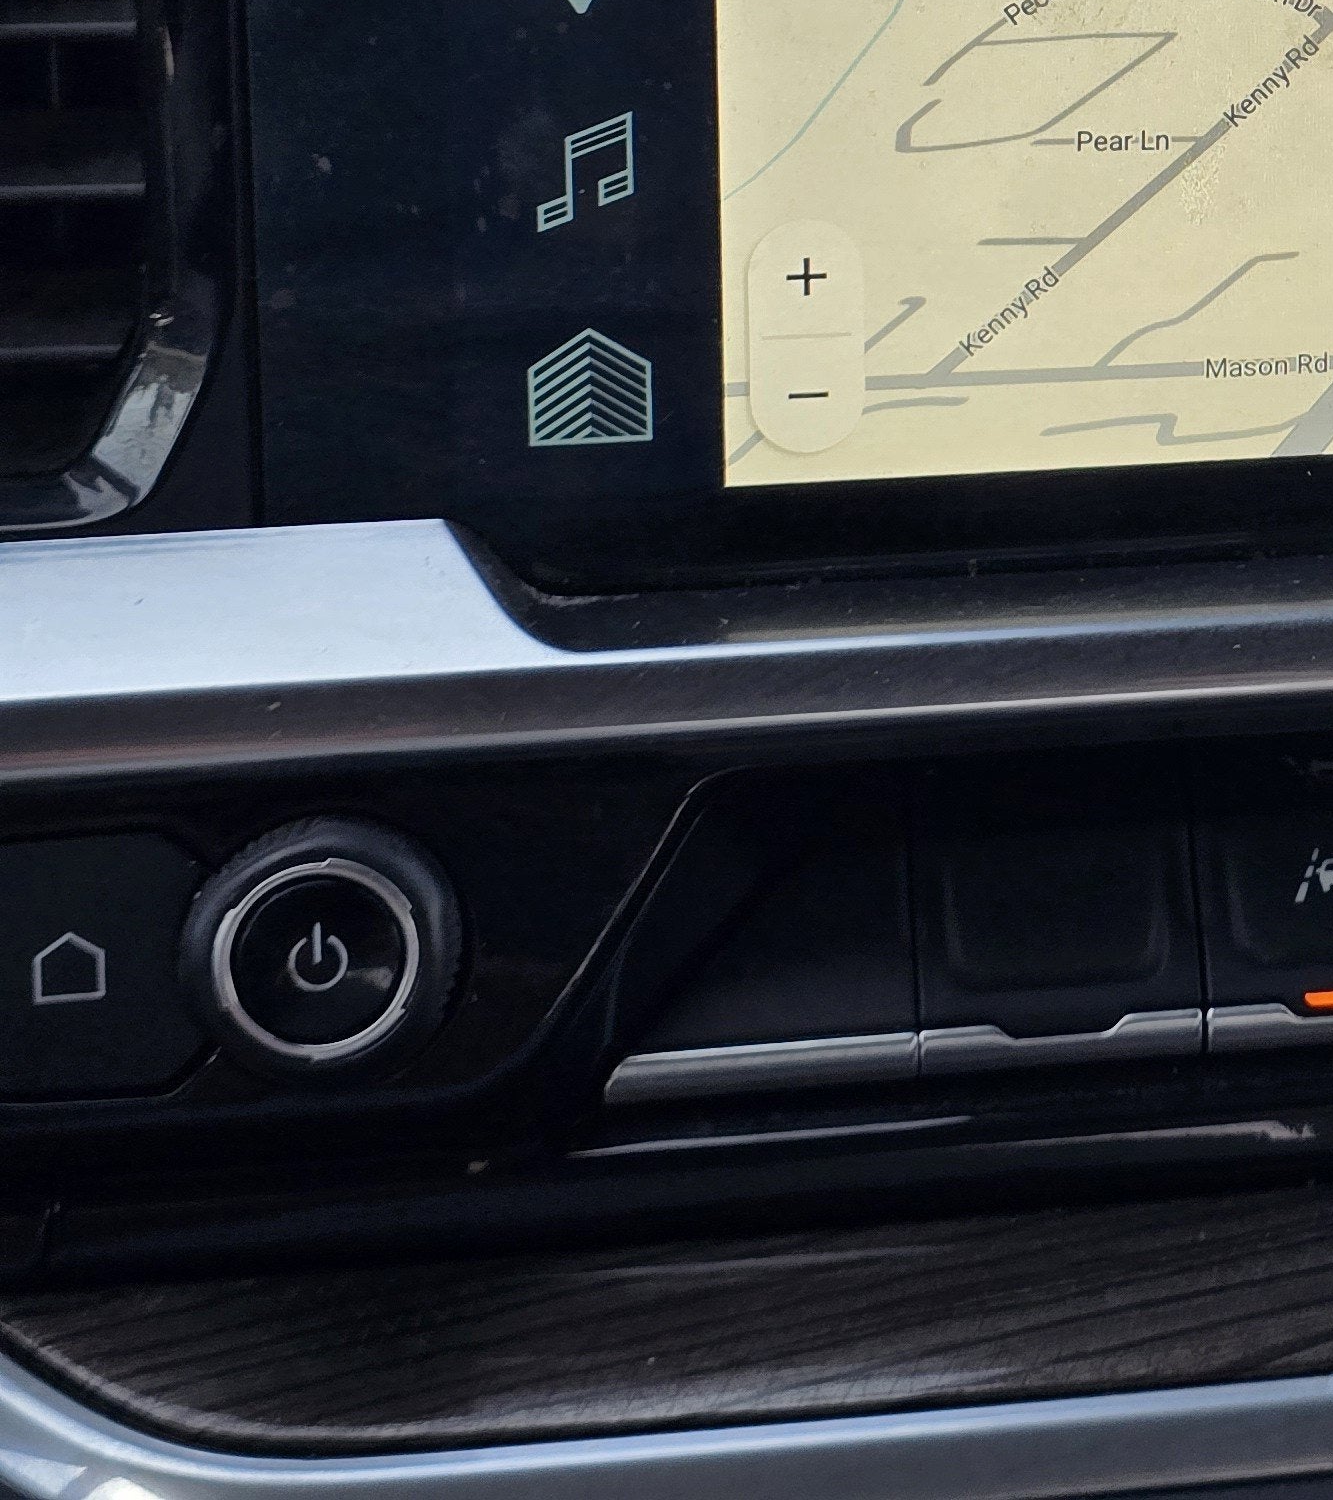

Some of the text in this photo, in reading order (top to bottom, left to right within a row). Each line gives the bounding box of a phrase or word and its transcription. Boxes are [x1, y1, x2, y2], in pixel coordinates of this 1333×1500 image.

[1223, 34, 1320, 127] Kenny Rd
[1076, 130, 1170, 152] Pear Ln
[959, 265, 1060, 357] Kenny Rd
[1204, 352, 1329, 379] Mason Rd
